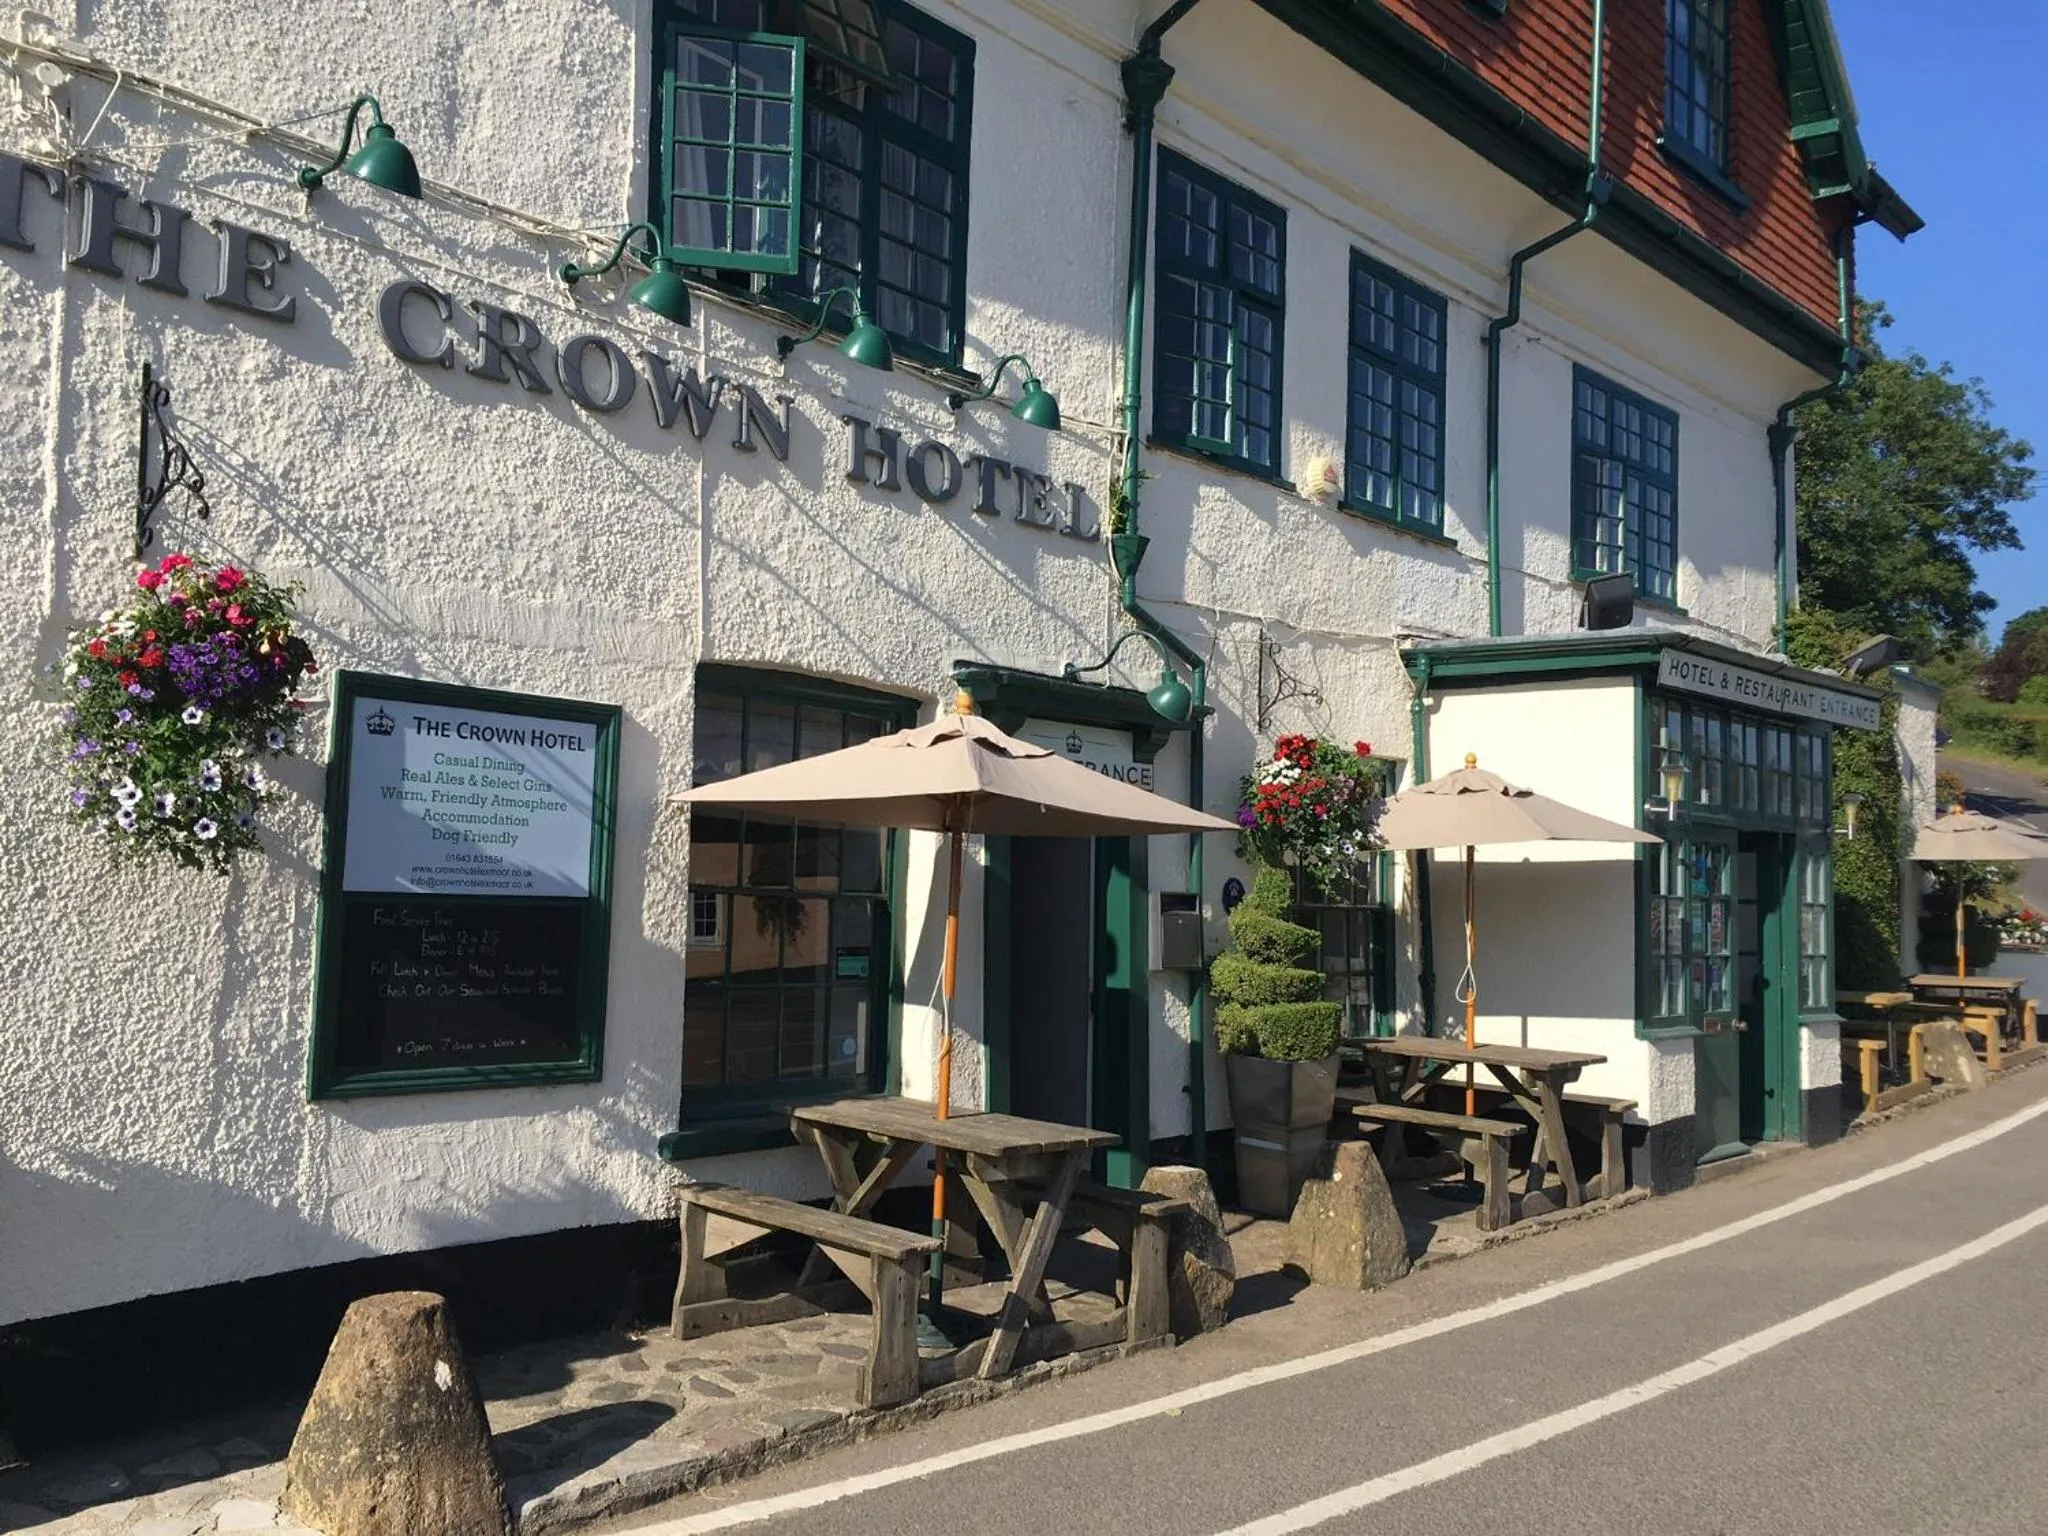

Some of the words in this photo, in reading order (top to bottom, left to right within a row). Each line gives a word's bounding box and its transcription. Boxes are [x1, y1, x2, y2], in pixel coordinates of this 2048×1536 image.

[0, 156, 296, 324] THE
[377, 279, 796, 461] CROWN
[842, 414, 1101, 542] HOTEL
[1670, 659, 1715, 687] HOTEL
[1720, 672, 1729, 690] &
[1735, 675, 1815, 710] RESTAURANT
[1820, 696, 1877, 724] ENTRANCE
[413, 716, 451, 738] THE
[456, 721, 526, 746] CROWN
[530, 731, 586, 752] HOTEL
[433, 753, 478, 769] Casual
[483, 757, 525, 775] Dining
[401, 769, 431, 783] Real
[435, 772, 465, 786] Ales
[468, 774, 478, 787] &
[481, 776, 520, 791] Select
[524, 779, 553, 793] Gins
[380, 786, 427, 803] Warm,
[431, 790, 488, 809] Friendly
[490, 794, 568, 813] Atmosphere
[422, 809, 530, 828] Accommodation
[432, 828, 460, 844] Dog
[463, 830, 519, 847] Friendly
